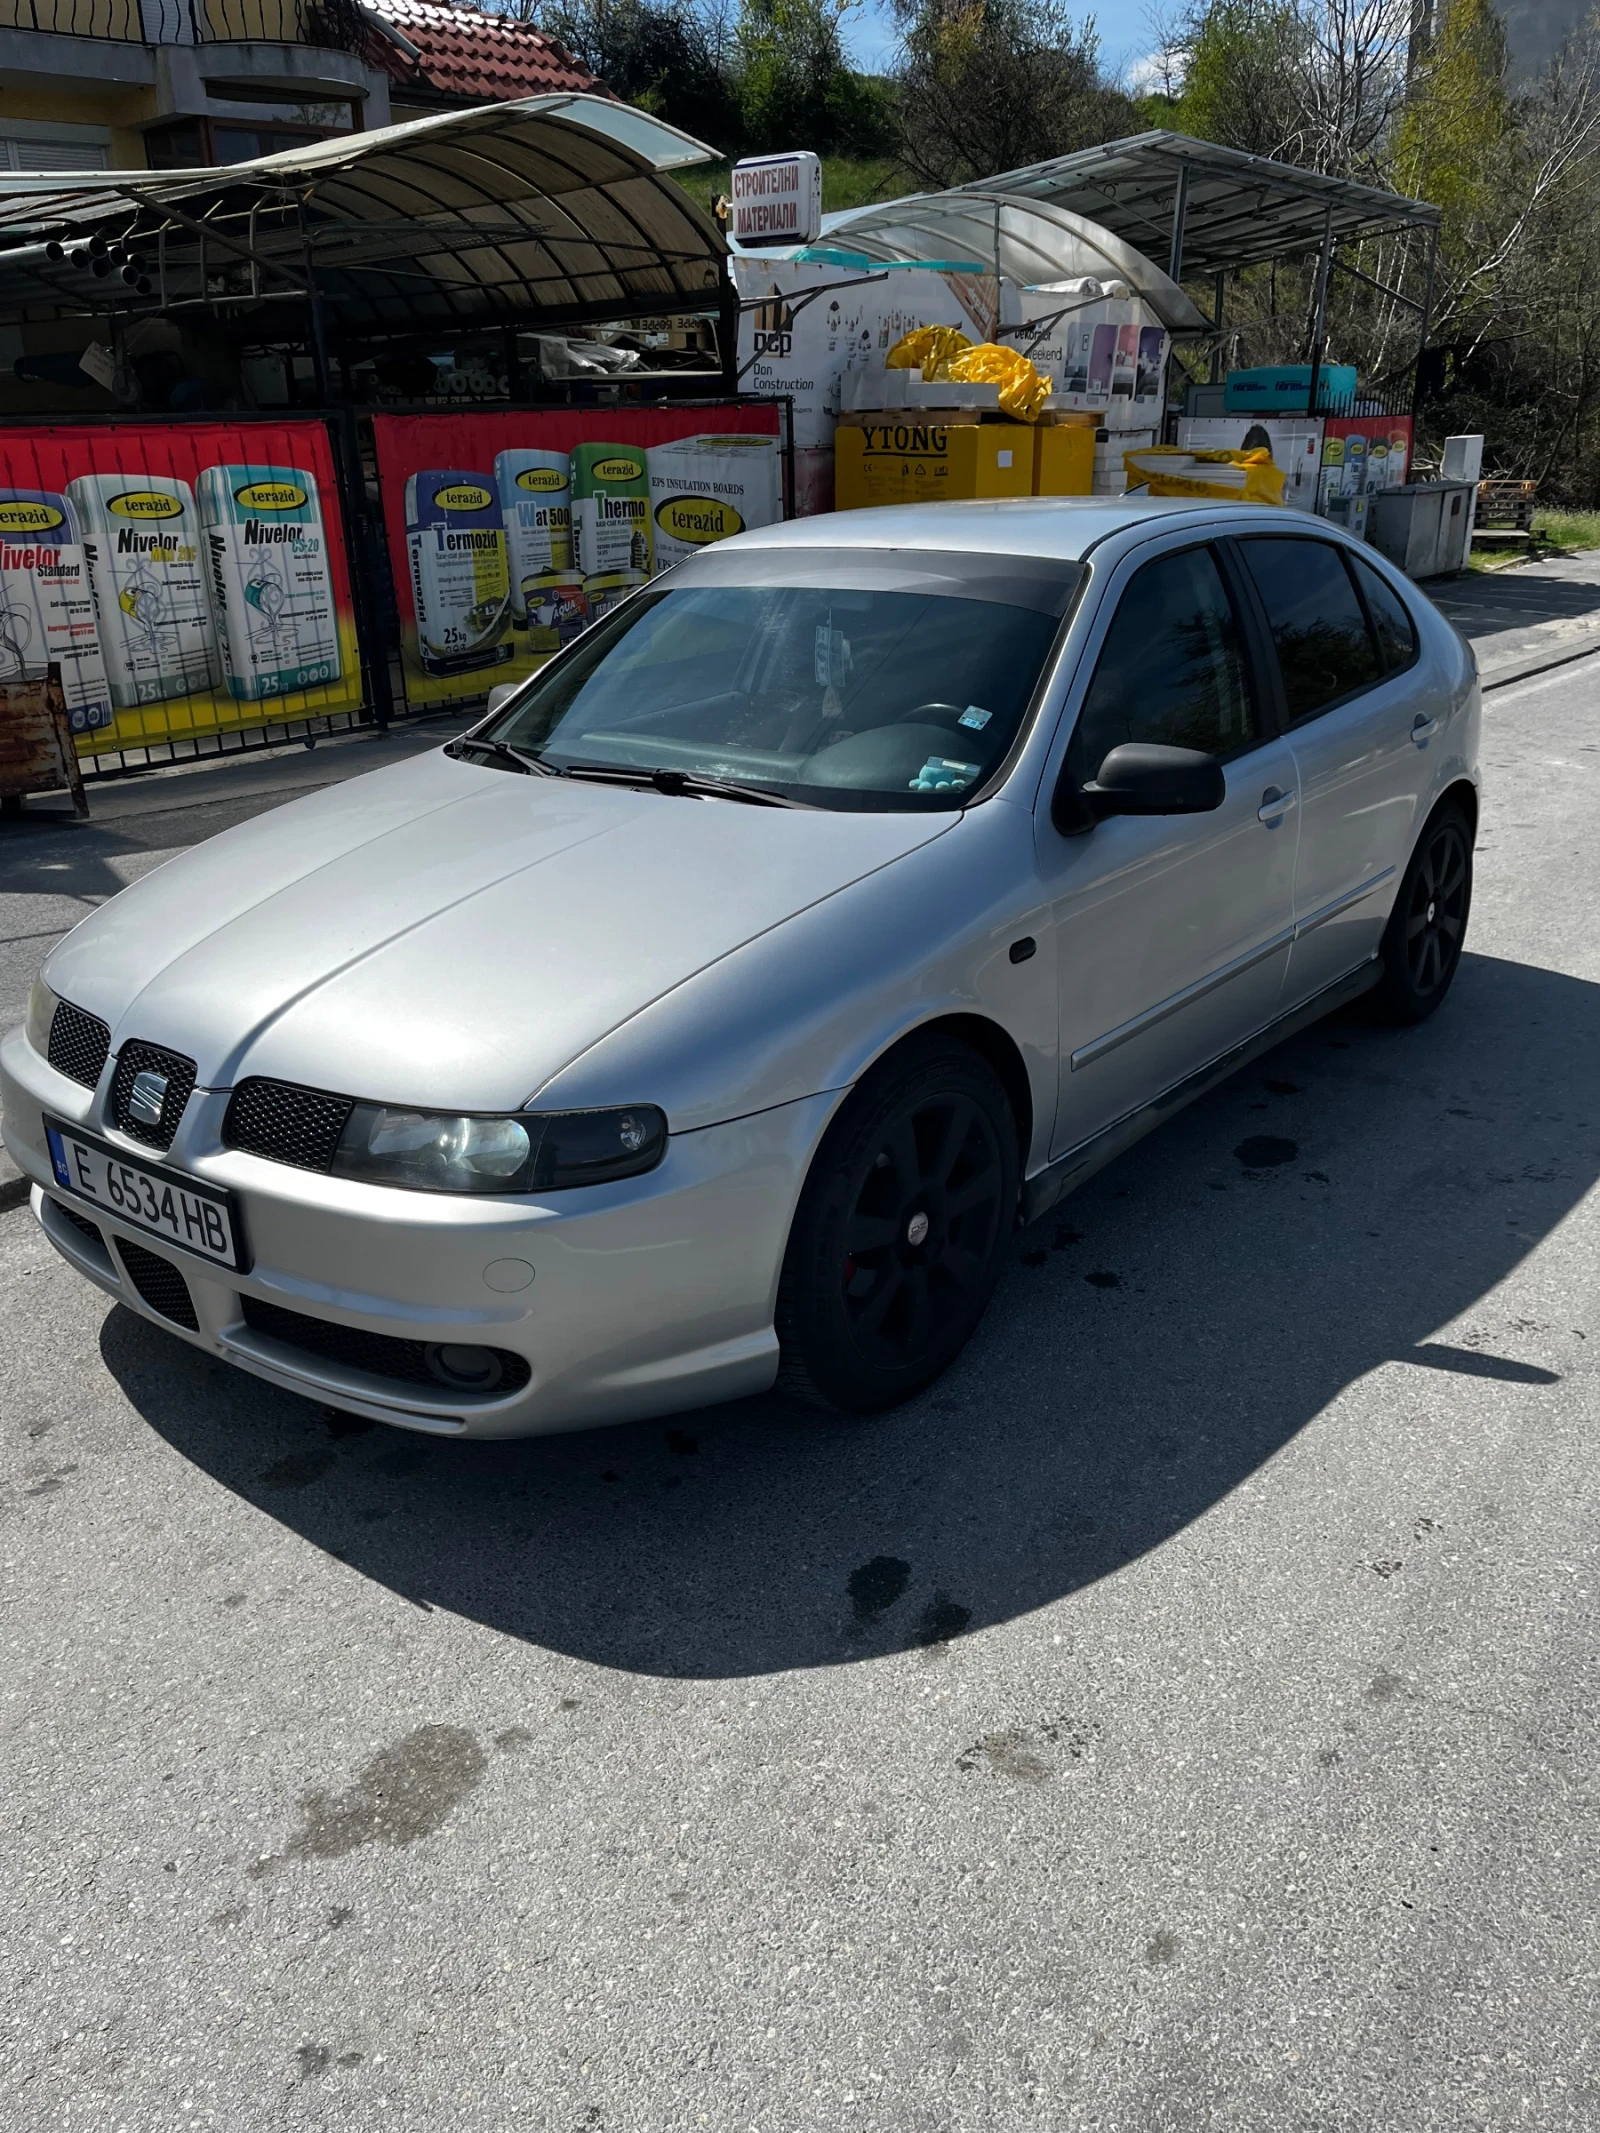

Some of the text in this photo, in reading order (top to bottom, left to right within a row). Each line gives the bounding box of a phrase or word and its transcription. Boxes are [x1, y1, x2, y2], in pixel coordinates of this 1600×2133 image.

[734, 165, 799, 198] СТРОИТЕЛНИ
[738, 202, 797, 233] МАТЕРИАЛИ
[753, 363, 773, 375] Don
[753, 377, 814, 390] Construction
[862, 426, 948, 451] YTONG
[602, 464, 634, 475] terazid
[528, 474, 561, 486] terazid
[651, 476, 745, 496] EPS INSULATION BOARDS
[125, 498, 172, 512] terazid
[251, 489, 296, 503] terazid
[446, 491, 483, 504] terazid
[593, 489, 646, 520] Thermo
[0, 509, 50, 523] erazid
[516, 501, 570, 528] Wat 500
[671, 506, 725, 533] terazid
[117, 527, 179, 554] Nivelor
[244, 518, 303, 545] Nivelor
[431, 522, 498, 552] Termozid
[37, 564, 80, 577] Standard
[411, 534, 427, 623] Termozid
[553, 599, 577, 619] AQUA
[443, 627, 467, 644] 25 kg
[138, 683, 157, 700] 25
[262, 676, 279, 694] 25
[57, 1160, 68, 1176] BG
[73, 1143, 96, 1194] E
